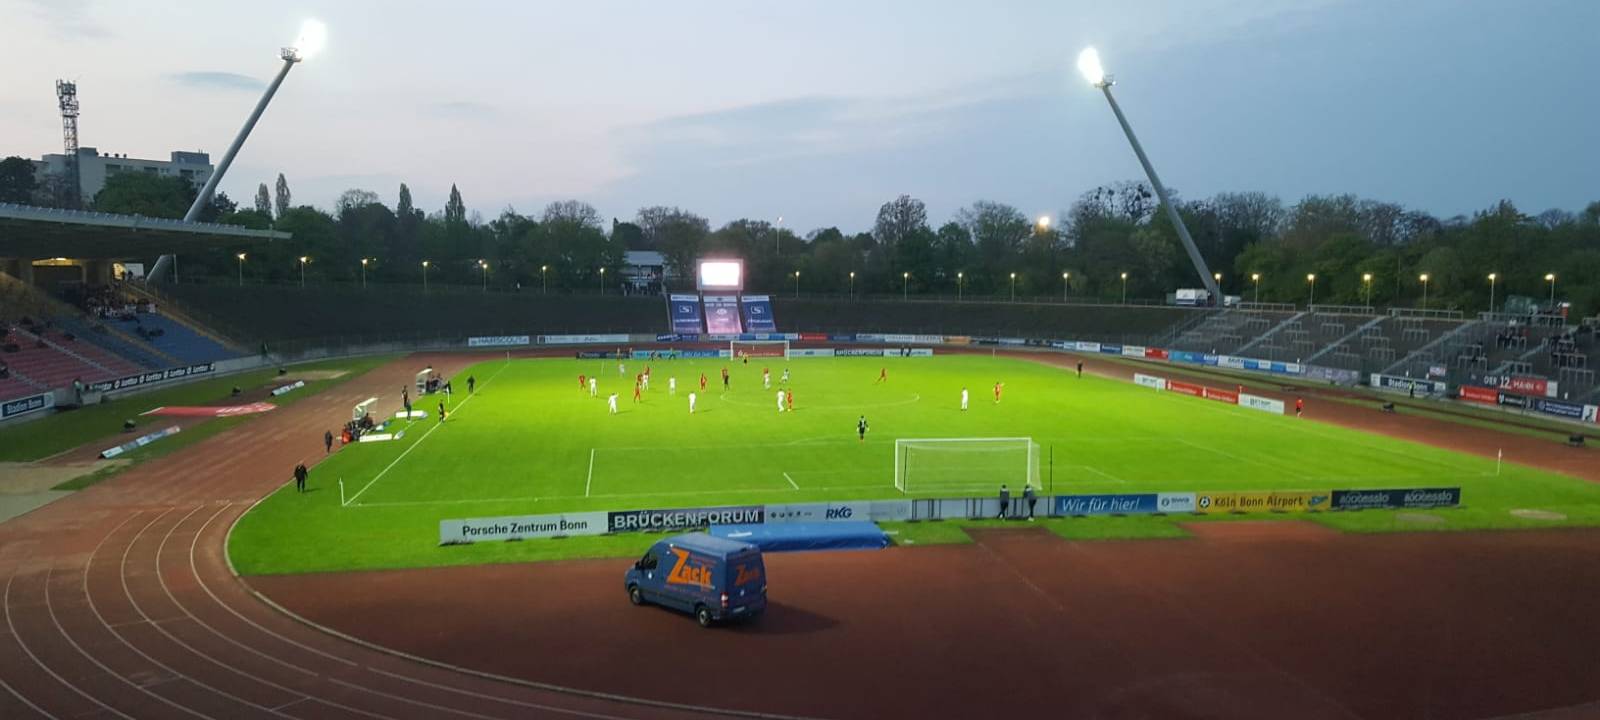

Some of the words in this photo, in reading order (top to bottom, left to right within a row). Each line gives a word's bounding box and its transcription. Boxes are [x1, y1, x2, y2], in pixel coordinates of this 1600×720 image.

[1500, 375, 1512, 389] 12
[1062, 496, 1084, 512] Wir
[1087, 495, 1106, 513] für
[1110, 495, 1140, 510] hier!
[1214, 496, 1236, 507] Köln
[1240, 496, 1263, 507] Bonn
[1266, 495, 1303, 508] Airport
[614, 508, 759, 529] BRÜCKENFORUM
[825, 505, 852, 519] RKG
[462, 525, 508, 537] Porsche
[510, 522, 557, 534] Zentrum
[560, 519, 588, 531] Bonn
[666, 547, 712, 586] Zack
